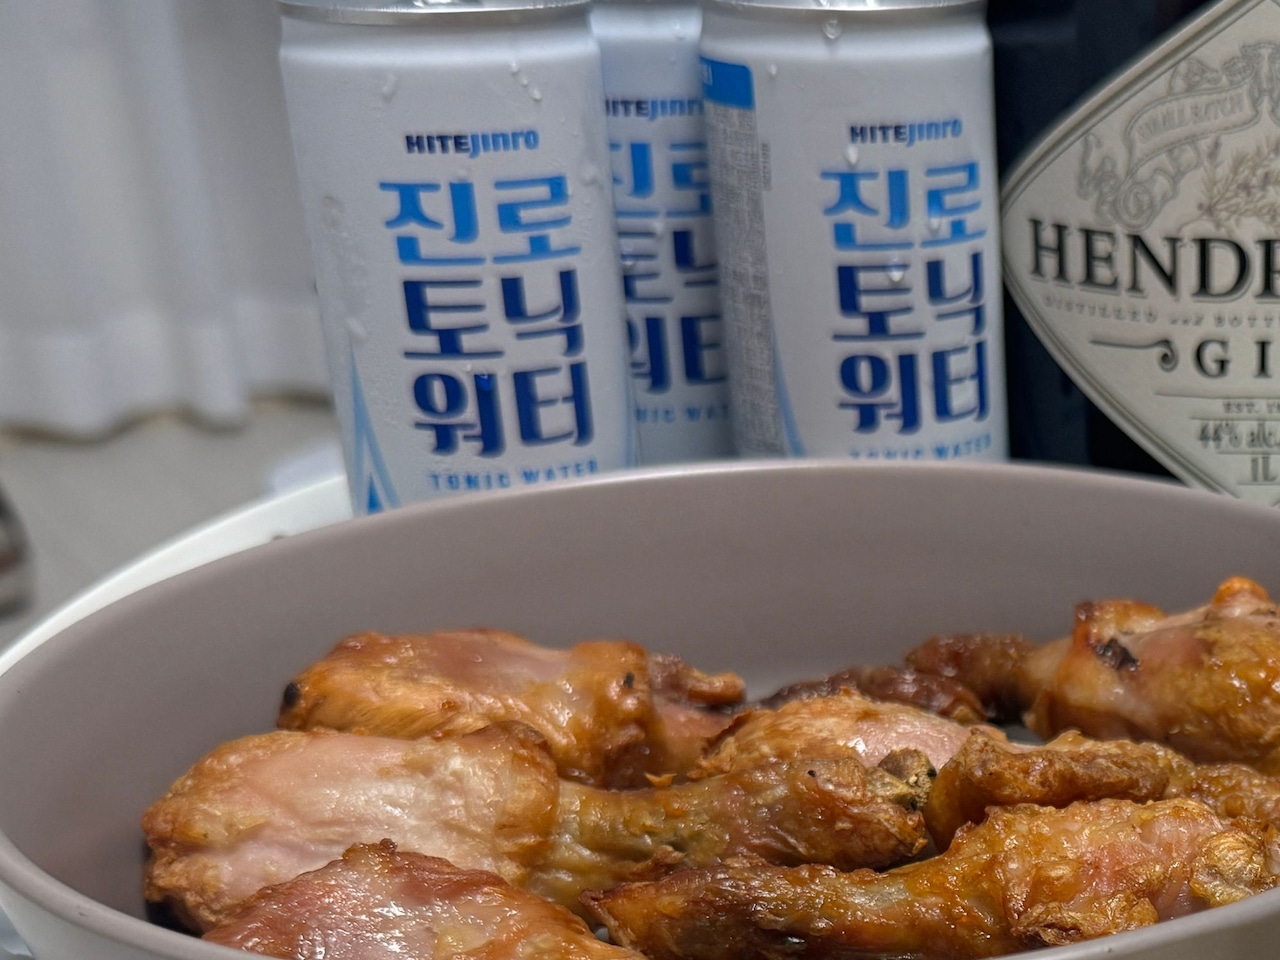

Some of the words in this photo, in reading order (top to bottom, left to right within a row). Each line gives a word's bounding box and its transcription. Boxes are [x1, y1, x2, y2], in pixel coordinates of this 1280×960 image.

[378, 174, 583, 268] 진로
[819, 160, 987, 252] 진로
[403, 268, 584, 361] 토닉
[832, 251, 986, 342] 토닉
[412, 358, 596, 459] 워터
[838, 339, 991, 435] 워터
[429, 470, 512, 492] TONIC
[521, 458, 600, 486] WATER
[1198, 421, 1243, 449] 44%
[1250, 456, 1278, 482] 1L
